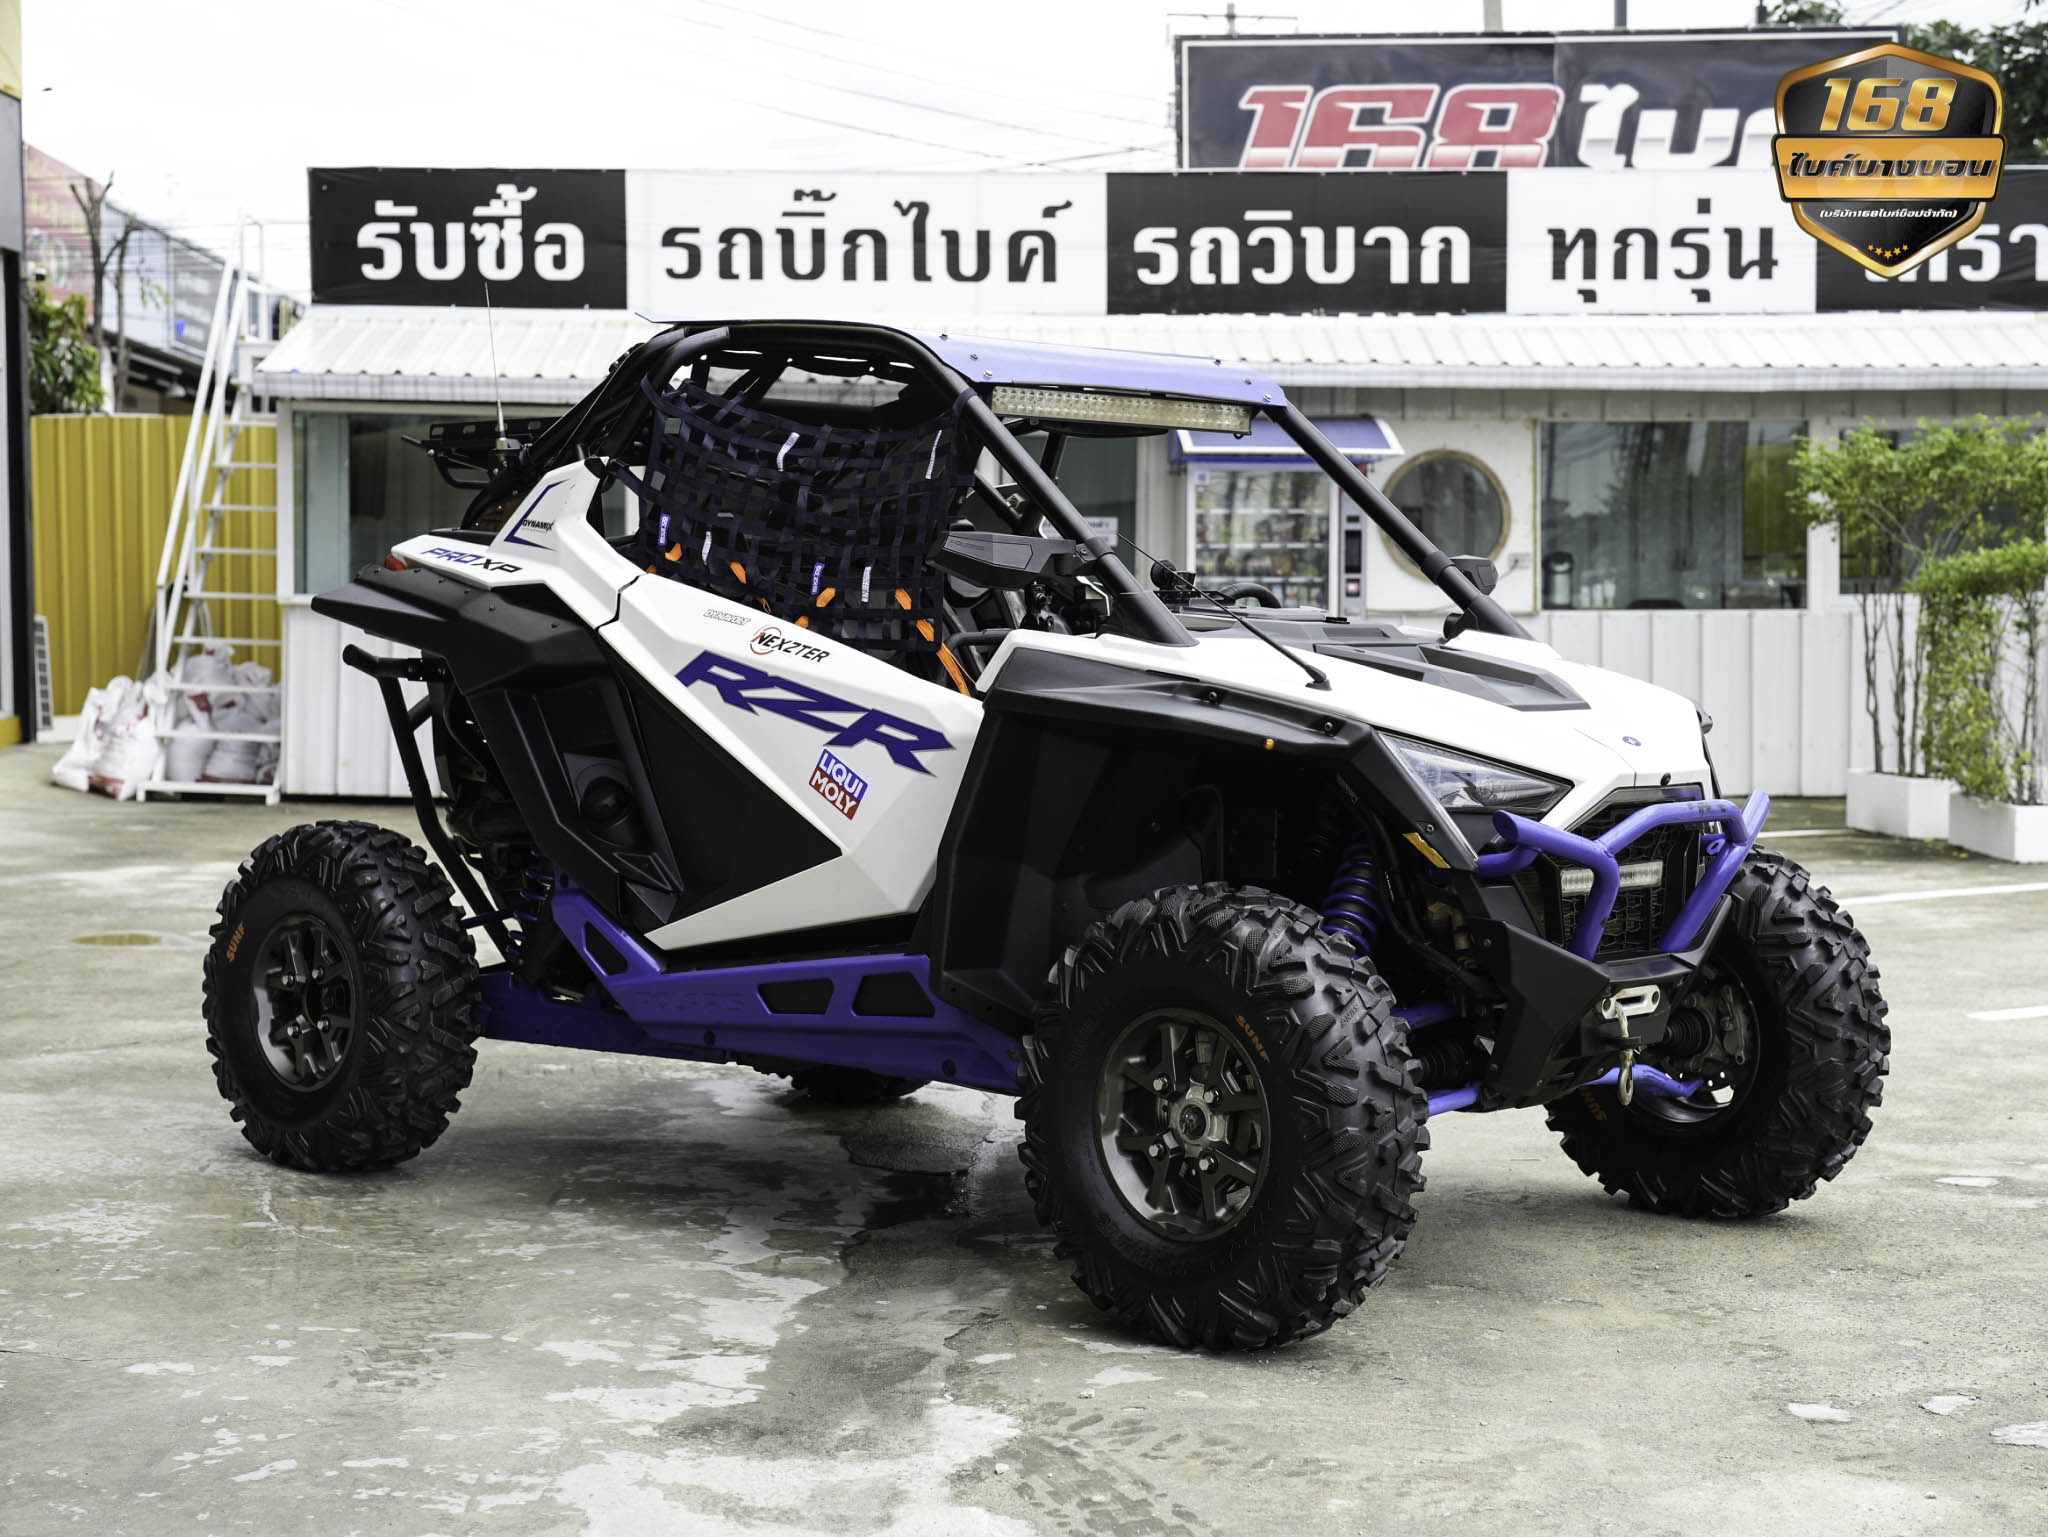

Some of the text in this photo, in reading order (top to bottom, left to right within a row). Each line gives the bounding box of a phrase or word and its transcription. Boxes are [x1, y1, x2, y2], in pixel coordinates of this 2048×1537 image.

[356, 183, 586, 281] รับซื้อ
[661, 189, 1073, 283] รถบิ๊กไบค์
[1133, 209, 1472, 286] รถวิบาก
[1546, 197, 1779, 304] ทุกรุ่น
[756, 632, 831, 663] NEXZTER
[674, 650, 958, 778] RZR
[810, 769, 857, 815] MOLY
[818, 751, 864, 799] LIQUI
